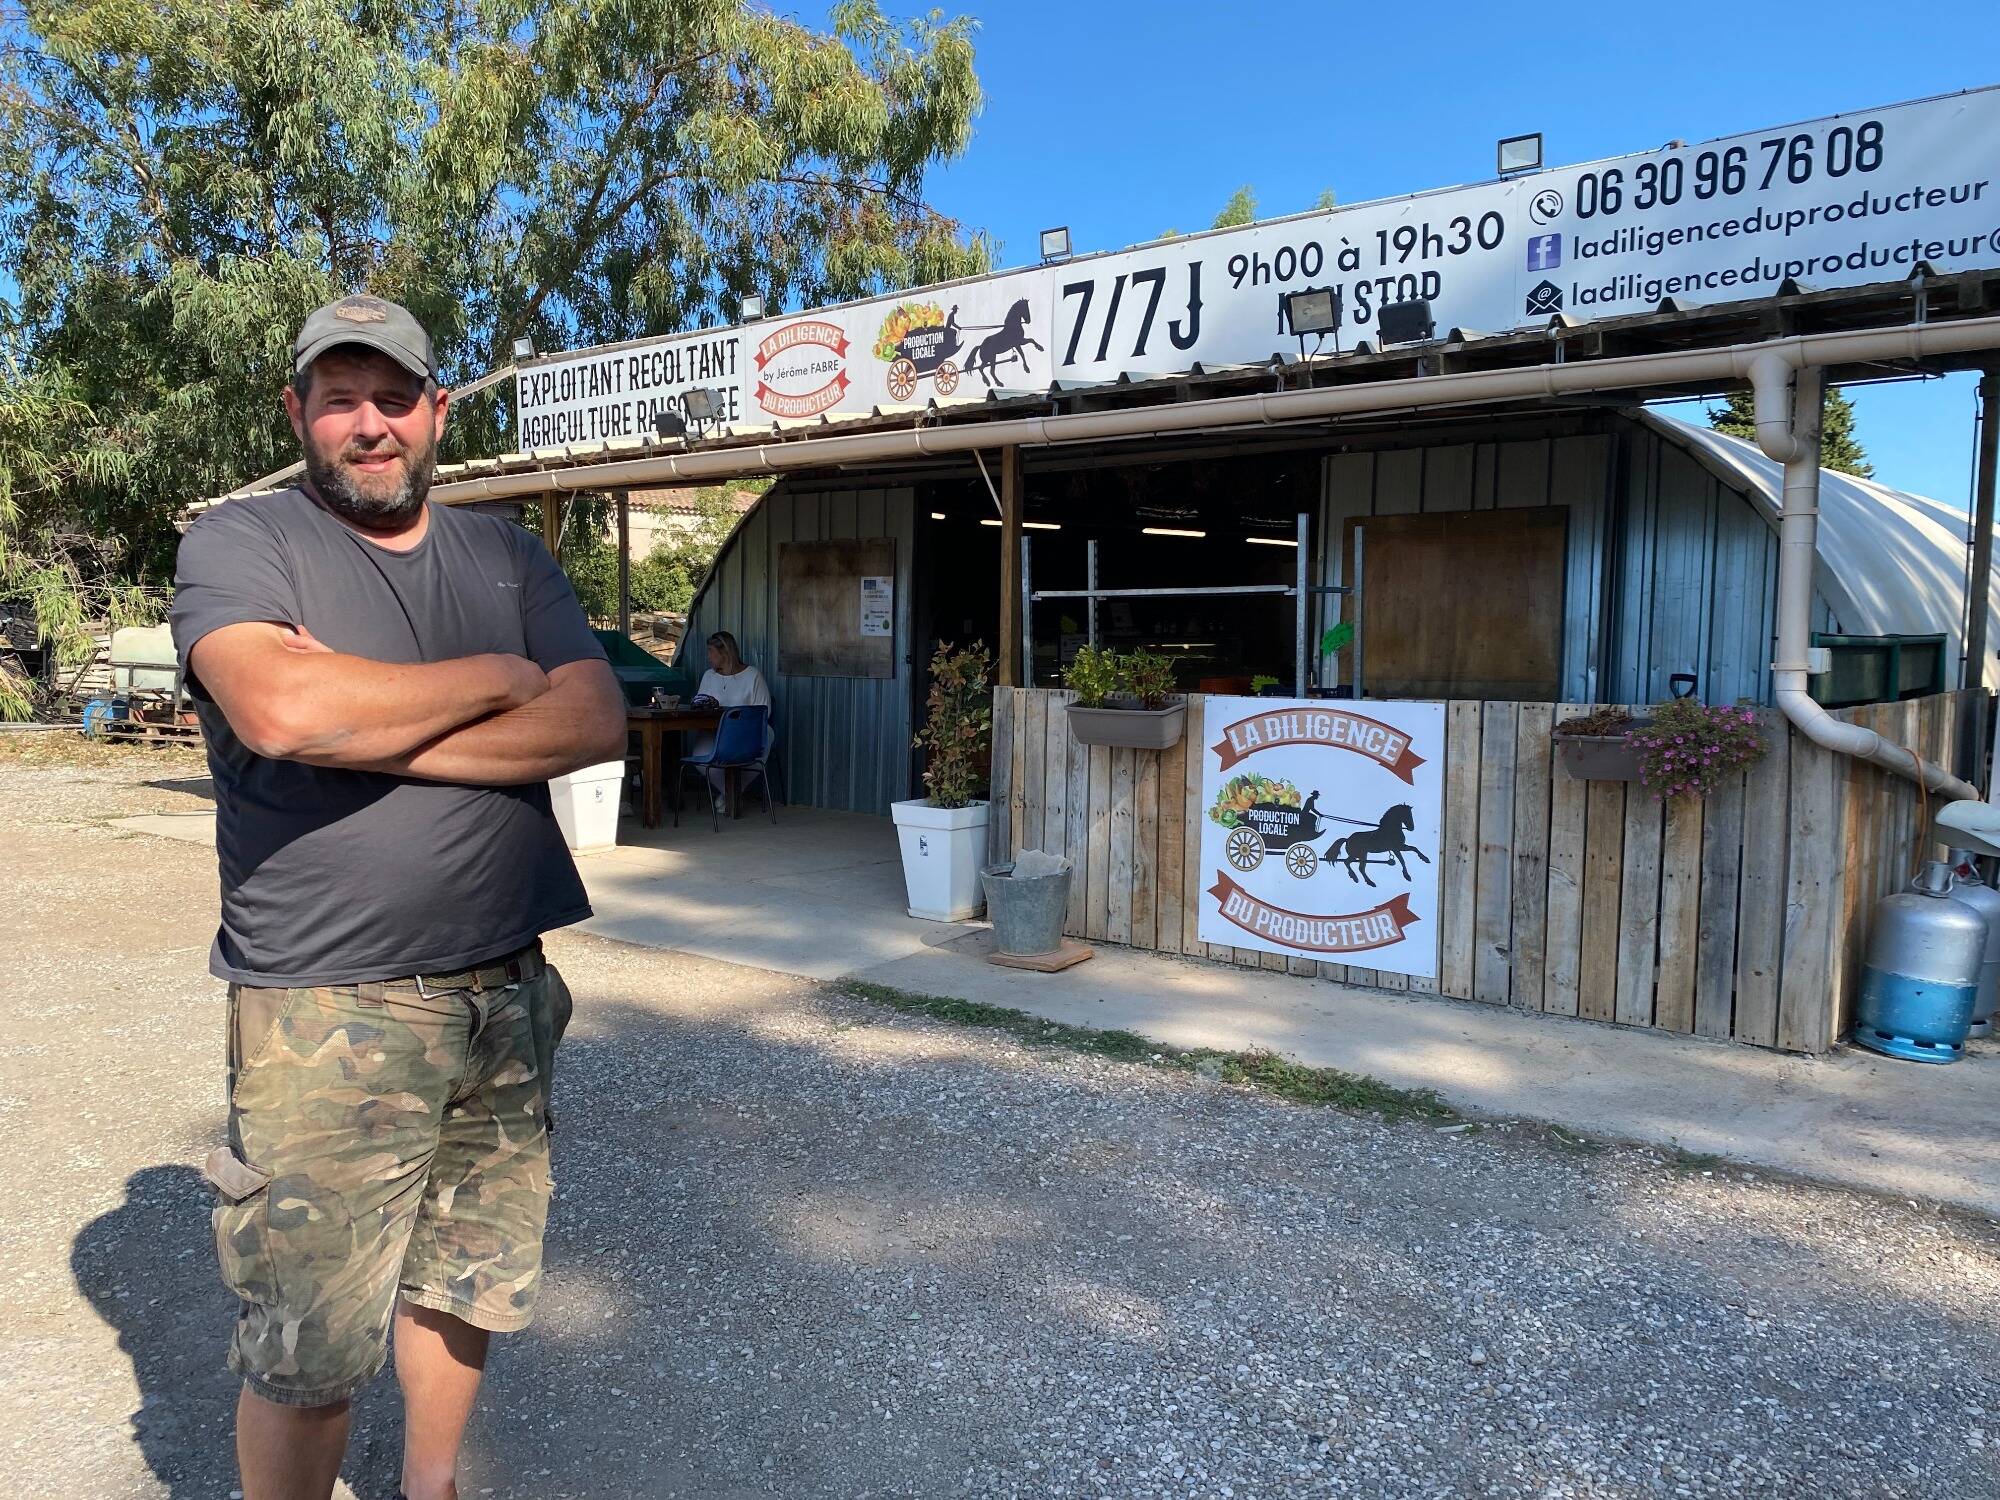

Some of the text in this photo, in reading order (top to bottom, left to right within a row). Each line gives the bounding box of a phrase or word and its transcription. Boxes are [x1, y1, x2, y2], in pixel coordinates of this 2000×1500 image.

[1576, 120, 1884, 219] 06 30 96 76 08
[1573, 180, 1989, 260] ladiligenceduproducteur
[1227, 210, 1505, 290] 9h00 à 19h30
[761, 325, 842, 359] LA DILIGENCE
[903, 331, 944, 350] PRODUCTION
[911, 345, 936, 360] LOCALE
[520, 337, 739, 409] EXPLOITANT RECOLTANT
[763, 359, 839, 383] by Jérôme FABRE
[763, 383, 842, 415] DU PRODUCTEUR
[522, 401, 632, 449] AGRICULTURE
[1229, 714, 1403, 762] LA DILIGENCE
[1248, 808, 1300, 826] PRODUCTION
[1258, 823, 1289, 837] LOCALE
[1224, 890, 1398, 947] DU PRODUCTEUR
